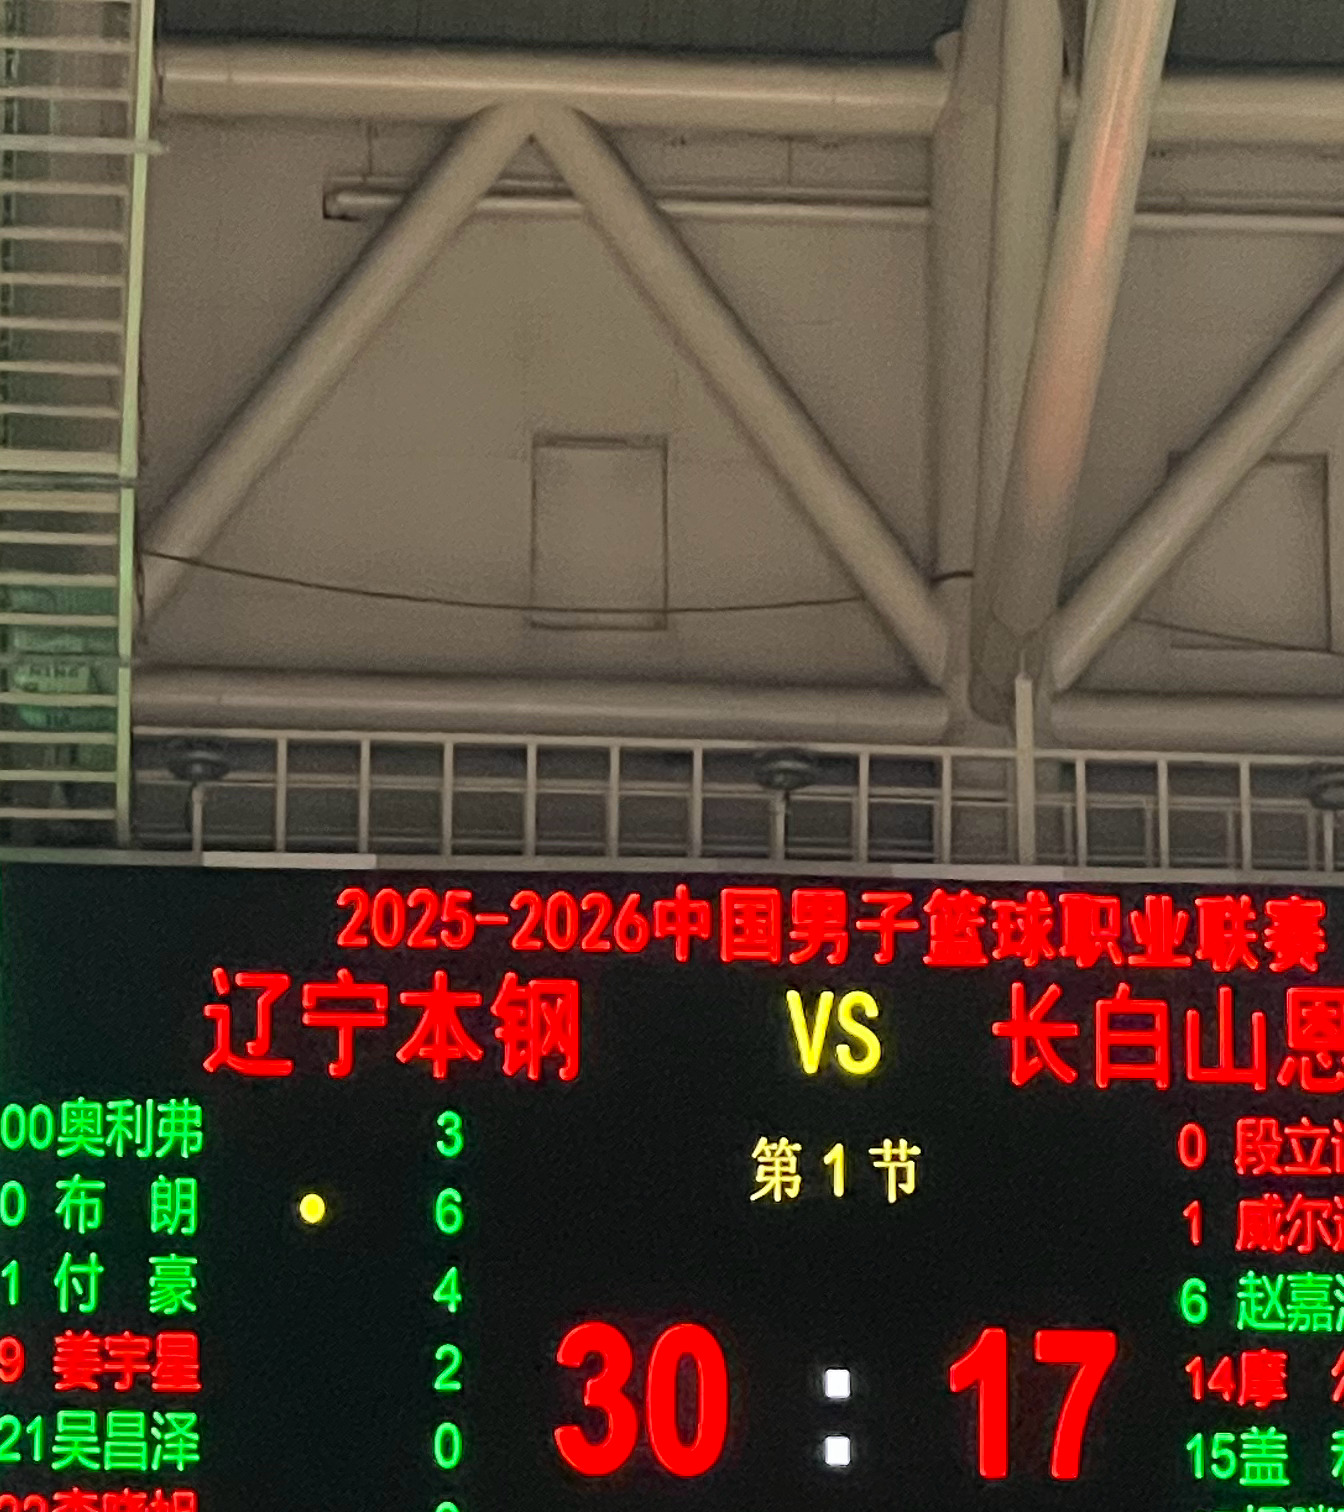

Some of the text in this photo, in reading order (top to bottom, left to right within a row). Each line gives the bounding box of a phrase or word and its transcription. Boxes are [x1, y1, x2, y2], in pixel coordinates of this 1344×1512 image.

[203, 968, 579, 1082] 辽宁本钢
[786, 990, 882, 1076] VS
[437, 1111, 463, 1157] 3
[1178, 1122, 1207, 1170] 0
[749, 1137, 921, 1203] 第 1 节
[0, 1180, 26, 1226] 0
[435, 1188, 463, 1234] 6
[1183, 1200, 1202, 1245] 1
[1, 1260, 18, 1305] 1
[433, 1267, 462, 1312] 4
[1179, 1278, 1208, 1324] 6
[53, 1330, 202, 1392] 姜宇星
[434, 1344, 462, 1390] 2
[554, 1320, 729, 1477] 30
[950, 1328, 1117, 1480] 17
[434, 1422, 462, 1469] 0
